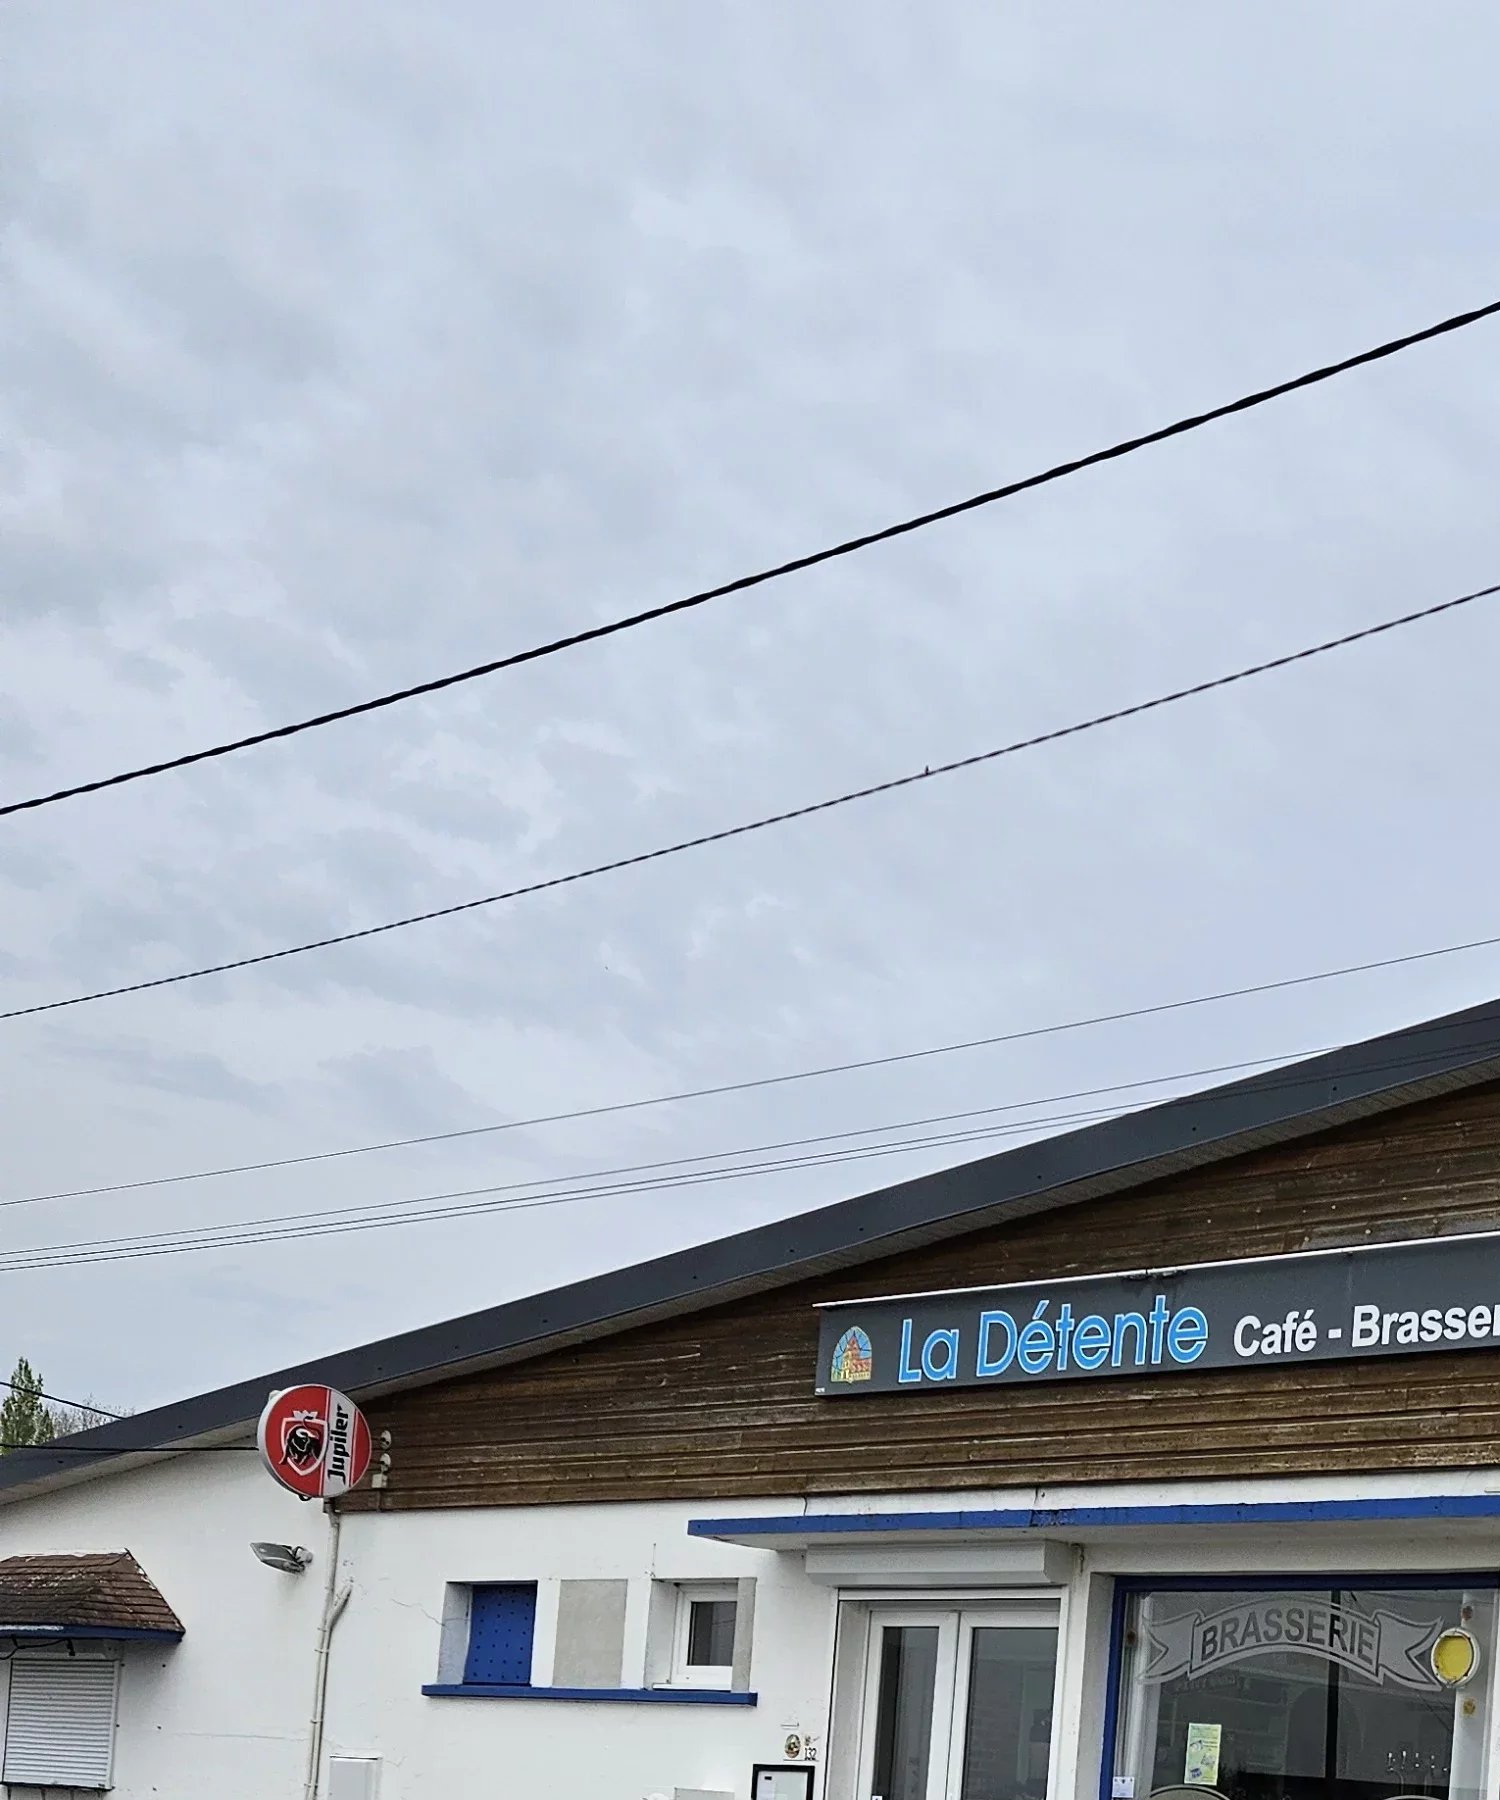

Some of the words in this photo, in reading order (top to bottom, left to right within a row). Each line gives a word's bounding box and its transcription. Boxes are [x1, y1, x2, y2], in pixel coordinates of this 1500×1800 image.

[898, 1319, 960, 1383] La
[976, 1295, 1209, 1377] Détente
[1233, 1309, 1317, 1357] Café
[327, 1403, 351, 1485] Jupiler
[1201, 1607, 1376, 1666] BRASSERIE
